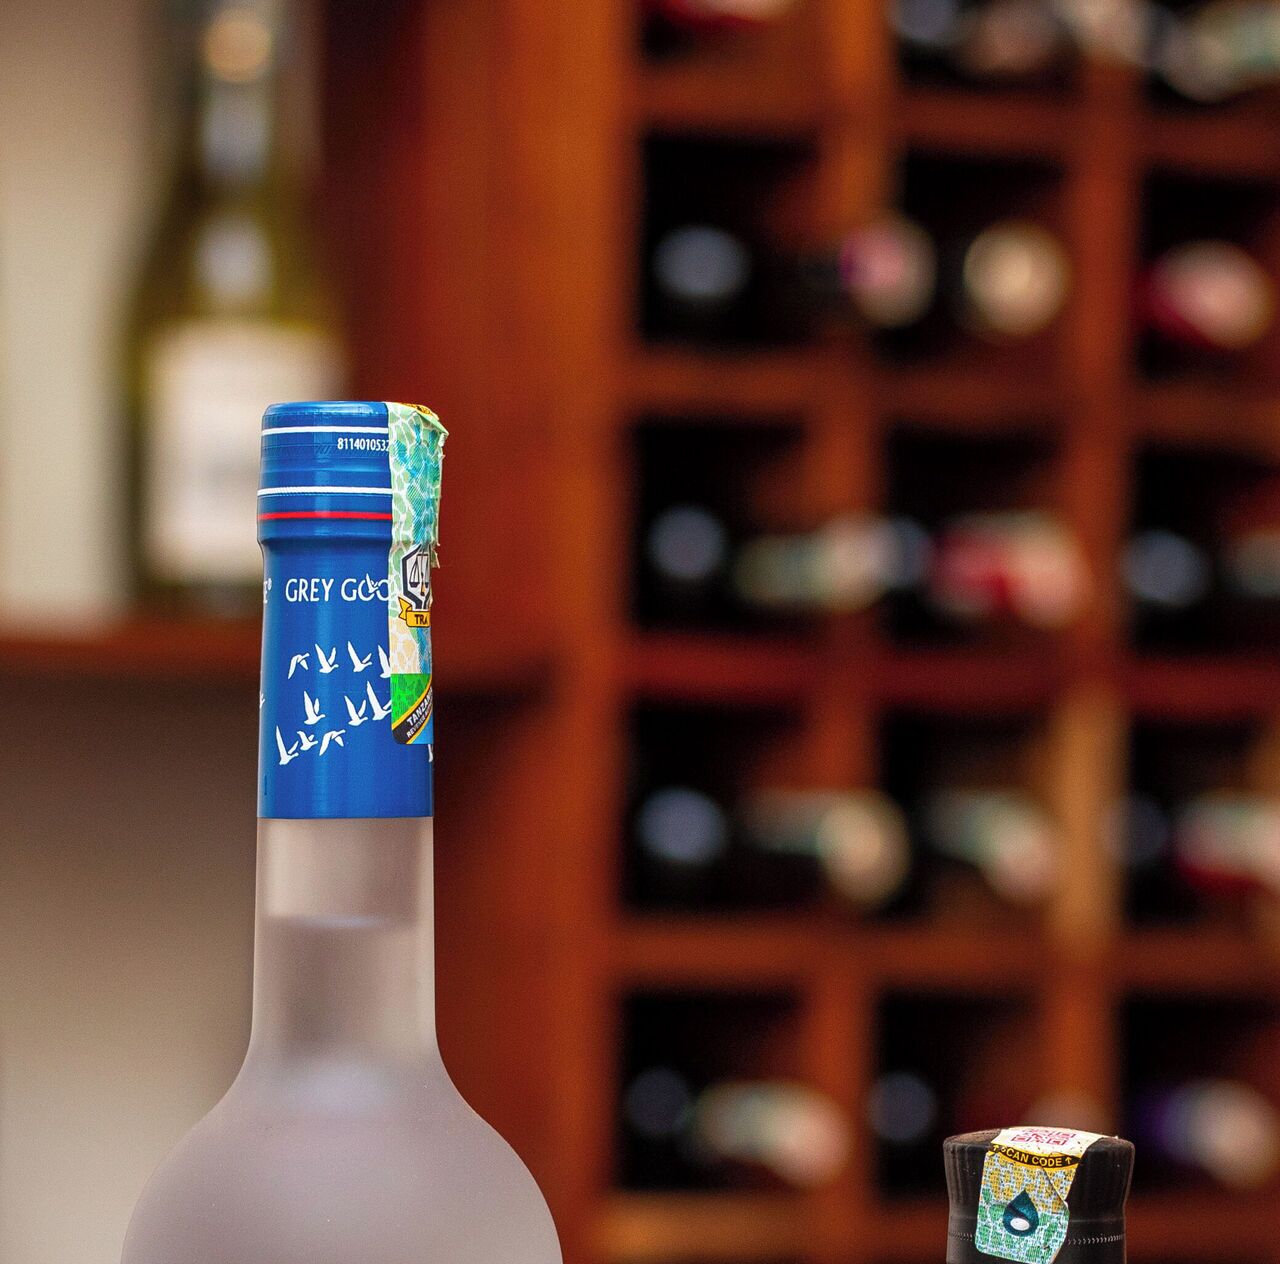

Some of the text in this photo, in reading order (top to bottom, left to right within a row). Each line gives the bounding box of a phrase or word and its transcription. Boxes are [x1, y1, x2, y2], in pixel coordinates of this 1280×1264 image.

[285, 578, 334, 602] GREY
[340, 573, 389, 602] GOO
[1031, 1156, 1063, 1167] CODE
